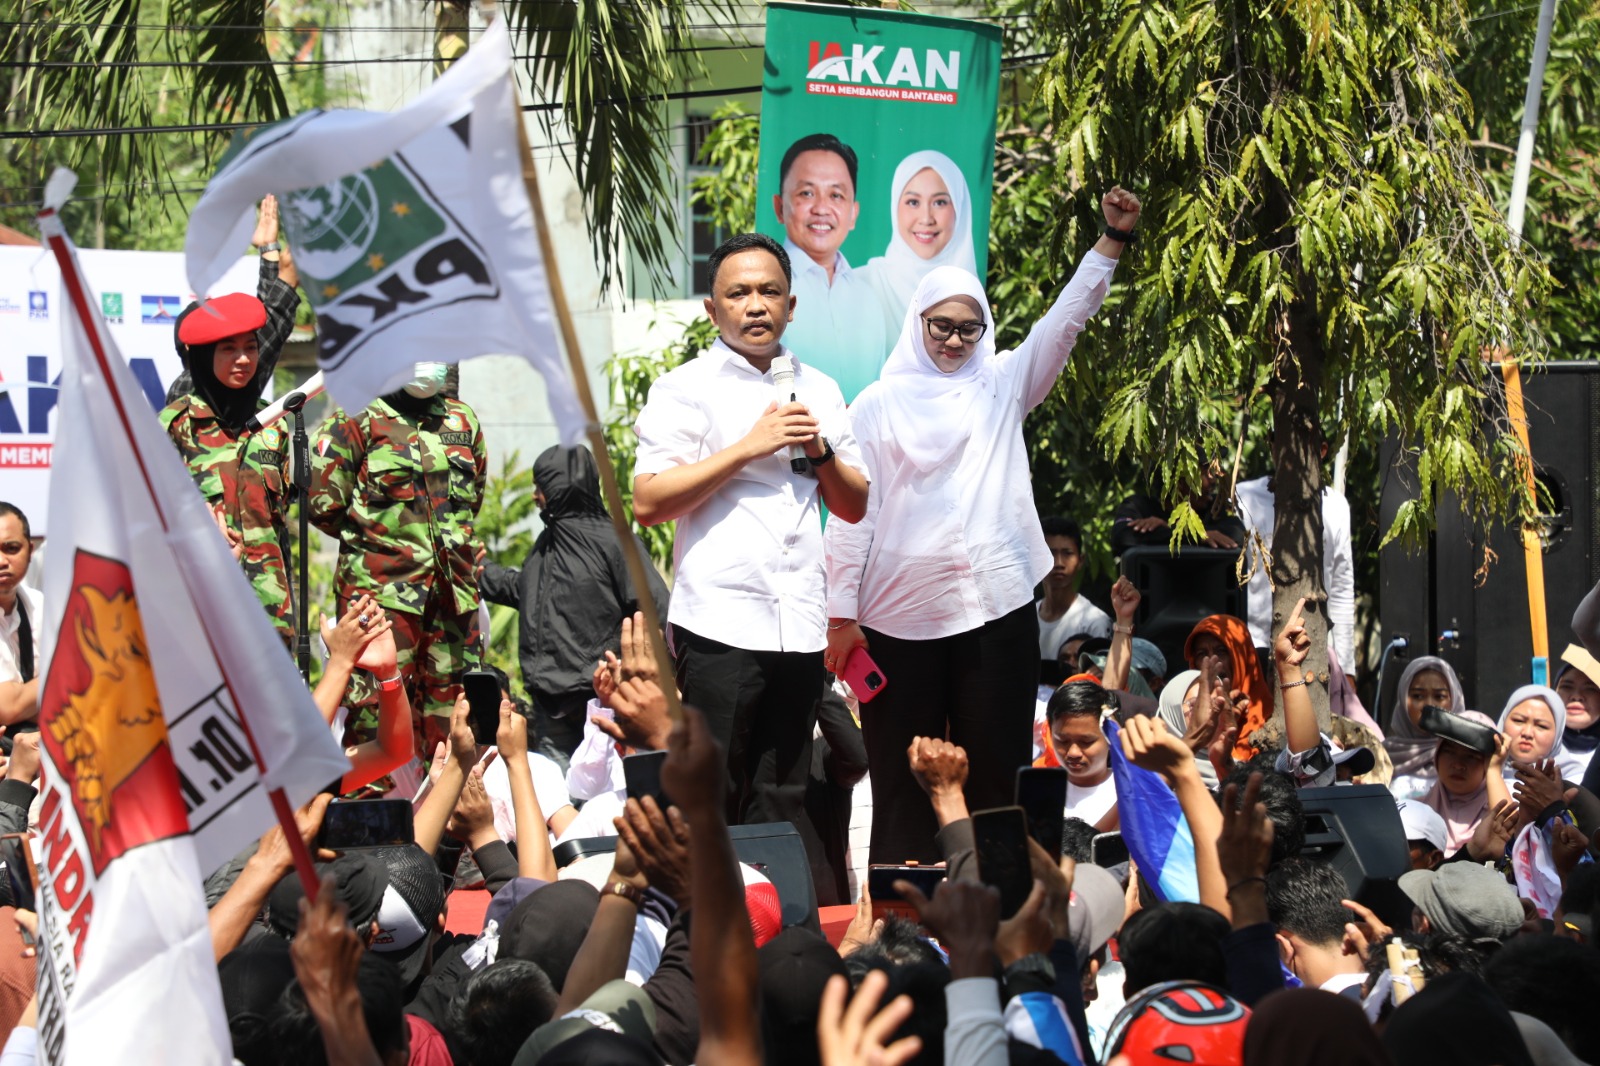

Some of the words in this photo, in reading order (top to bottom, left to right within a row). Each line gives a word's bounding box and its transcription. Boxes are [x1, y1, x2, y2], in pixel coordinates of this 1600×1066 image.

[808, 83, 836, 95] SETIA
[837, 85, 900, 99] MEMBANGUN
[901, 90, 954, 103] BANTAENG
